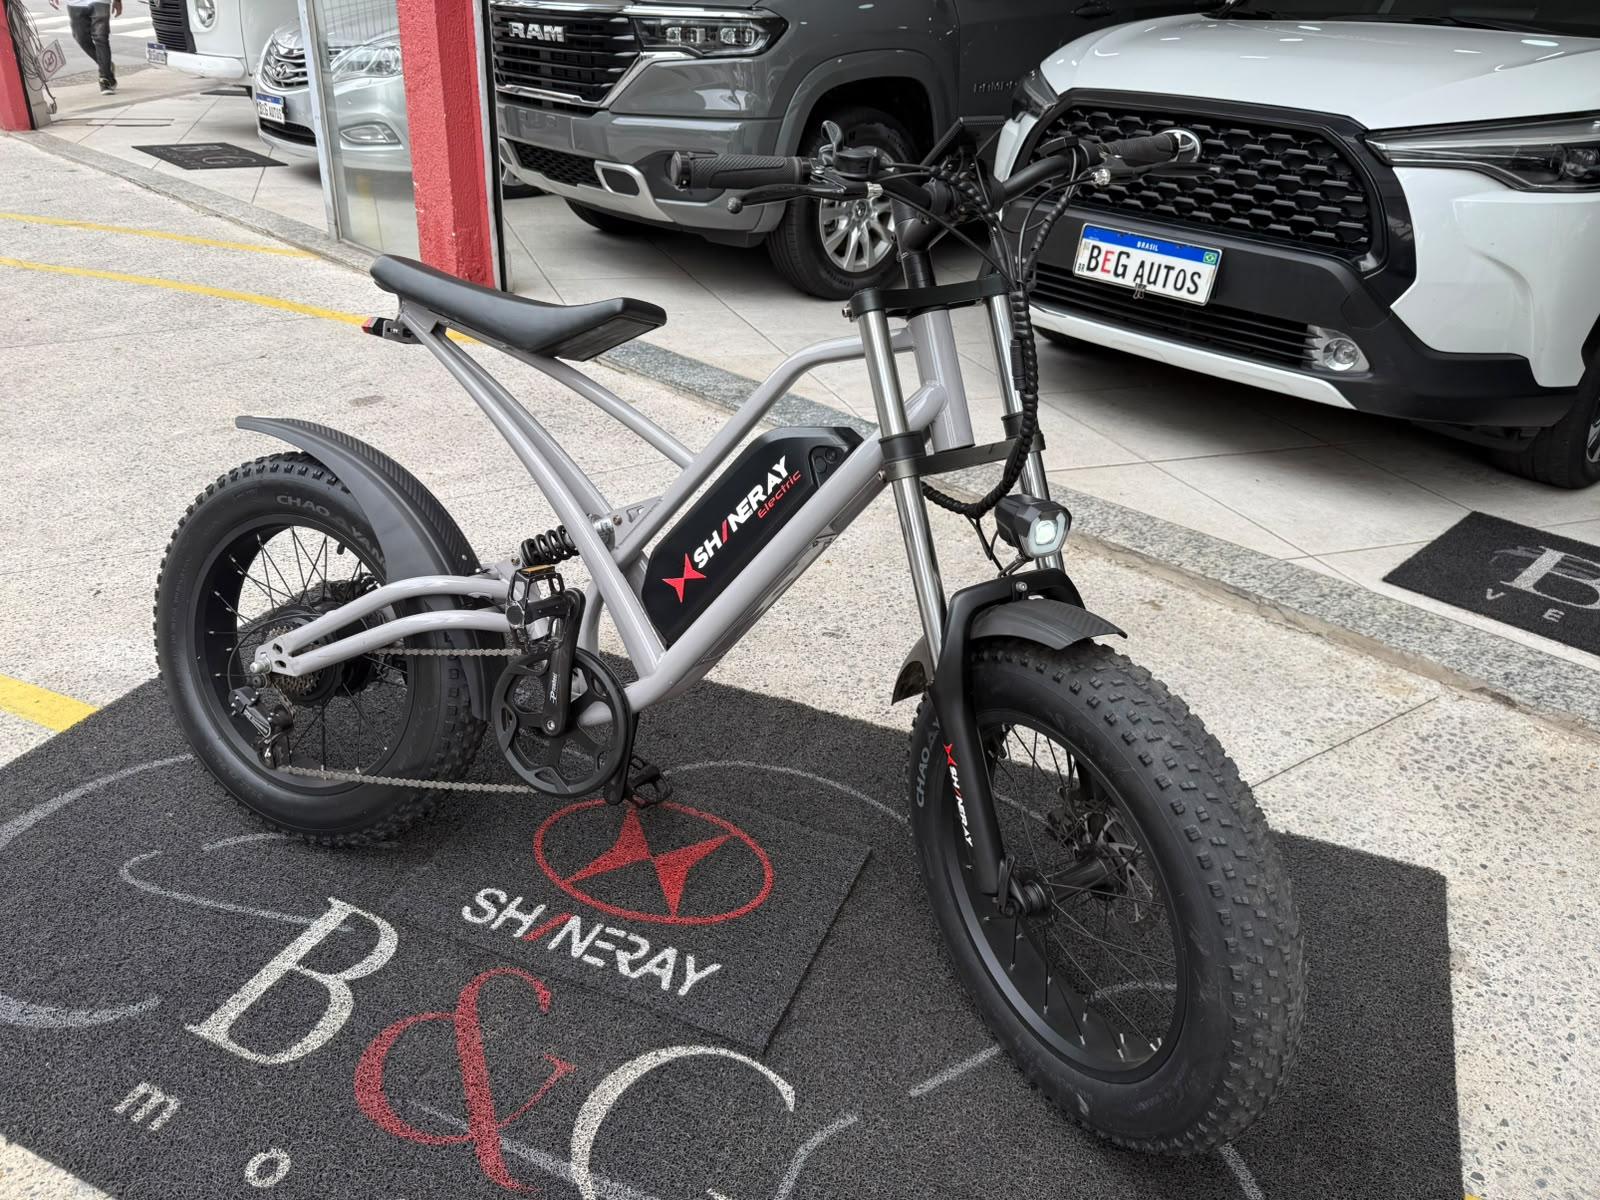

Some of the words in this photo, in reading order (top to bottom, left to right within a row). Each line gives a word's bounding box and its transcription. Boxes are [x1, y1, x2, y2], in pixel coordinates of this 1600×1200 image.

[508, 21, 565, 42] RAM
[1086, 244, 1130, 279] BEG
[1133, 259, 1201, 295] AUTOS
[1136, 240, 1158, 252] BRASIL
[693, 455, 788, 569] SHINERAY
[757, 470, 801, 519] Electric
